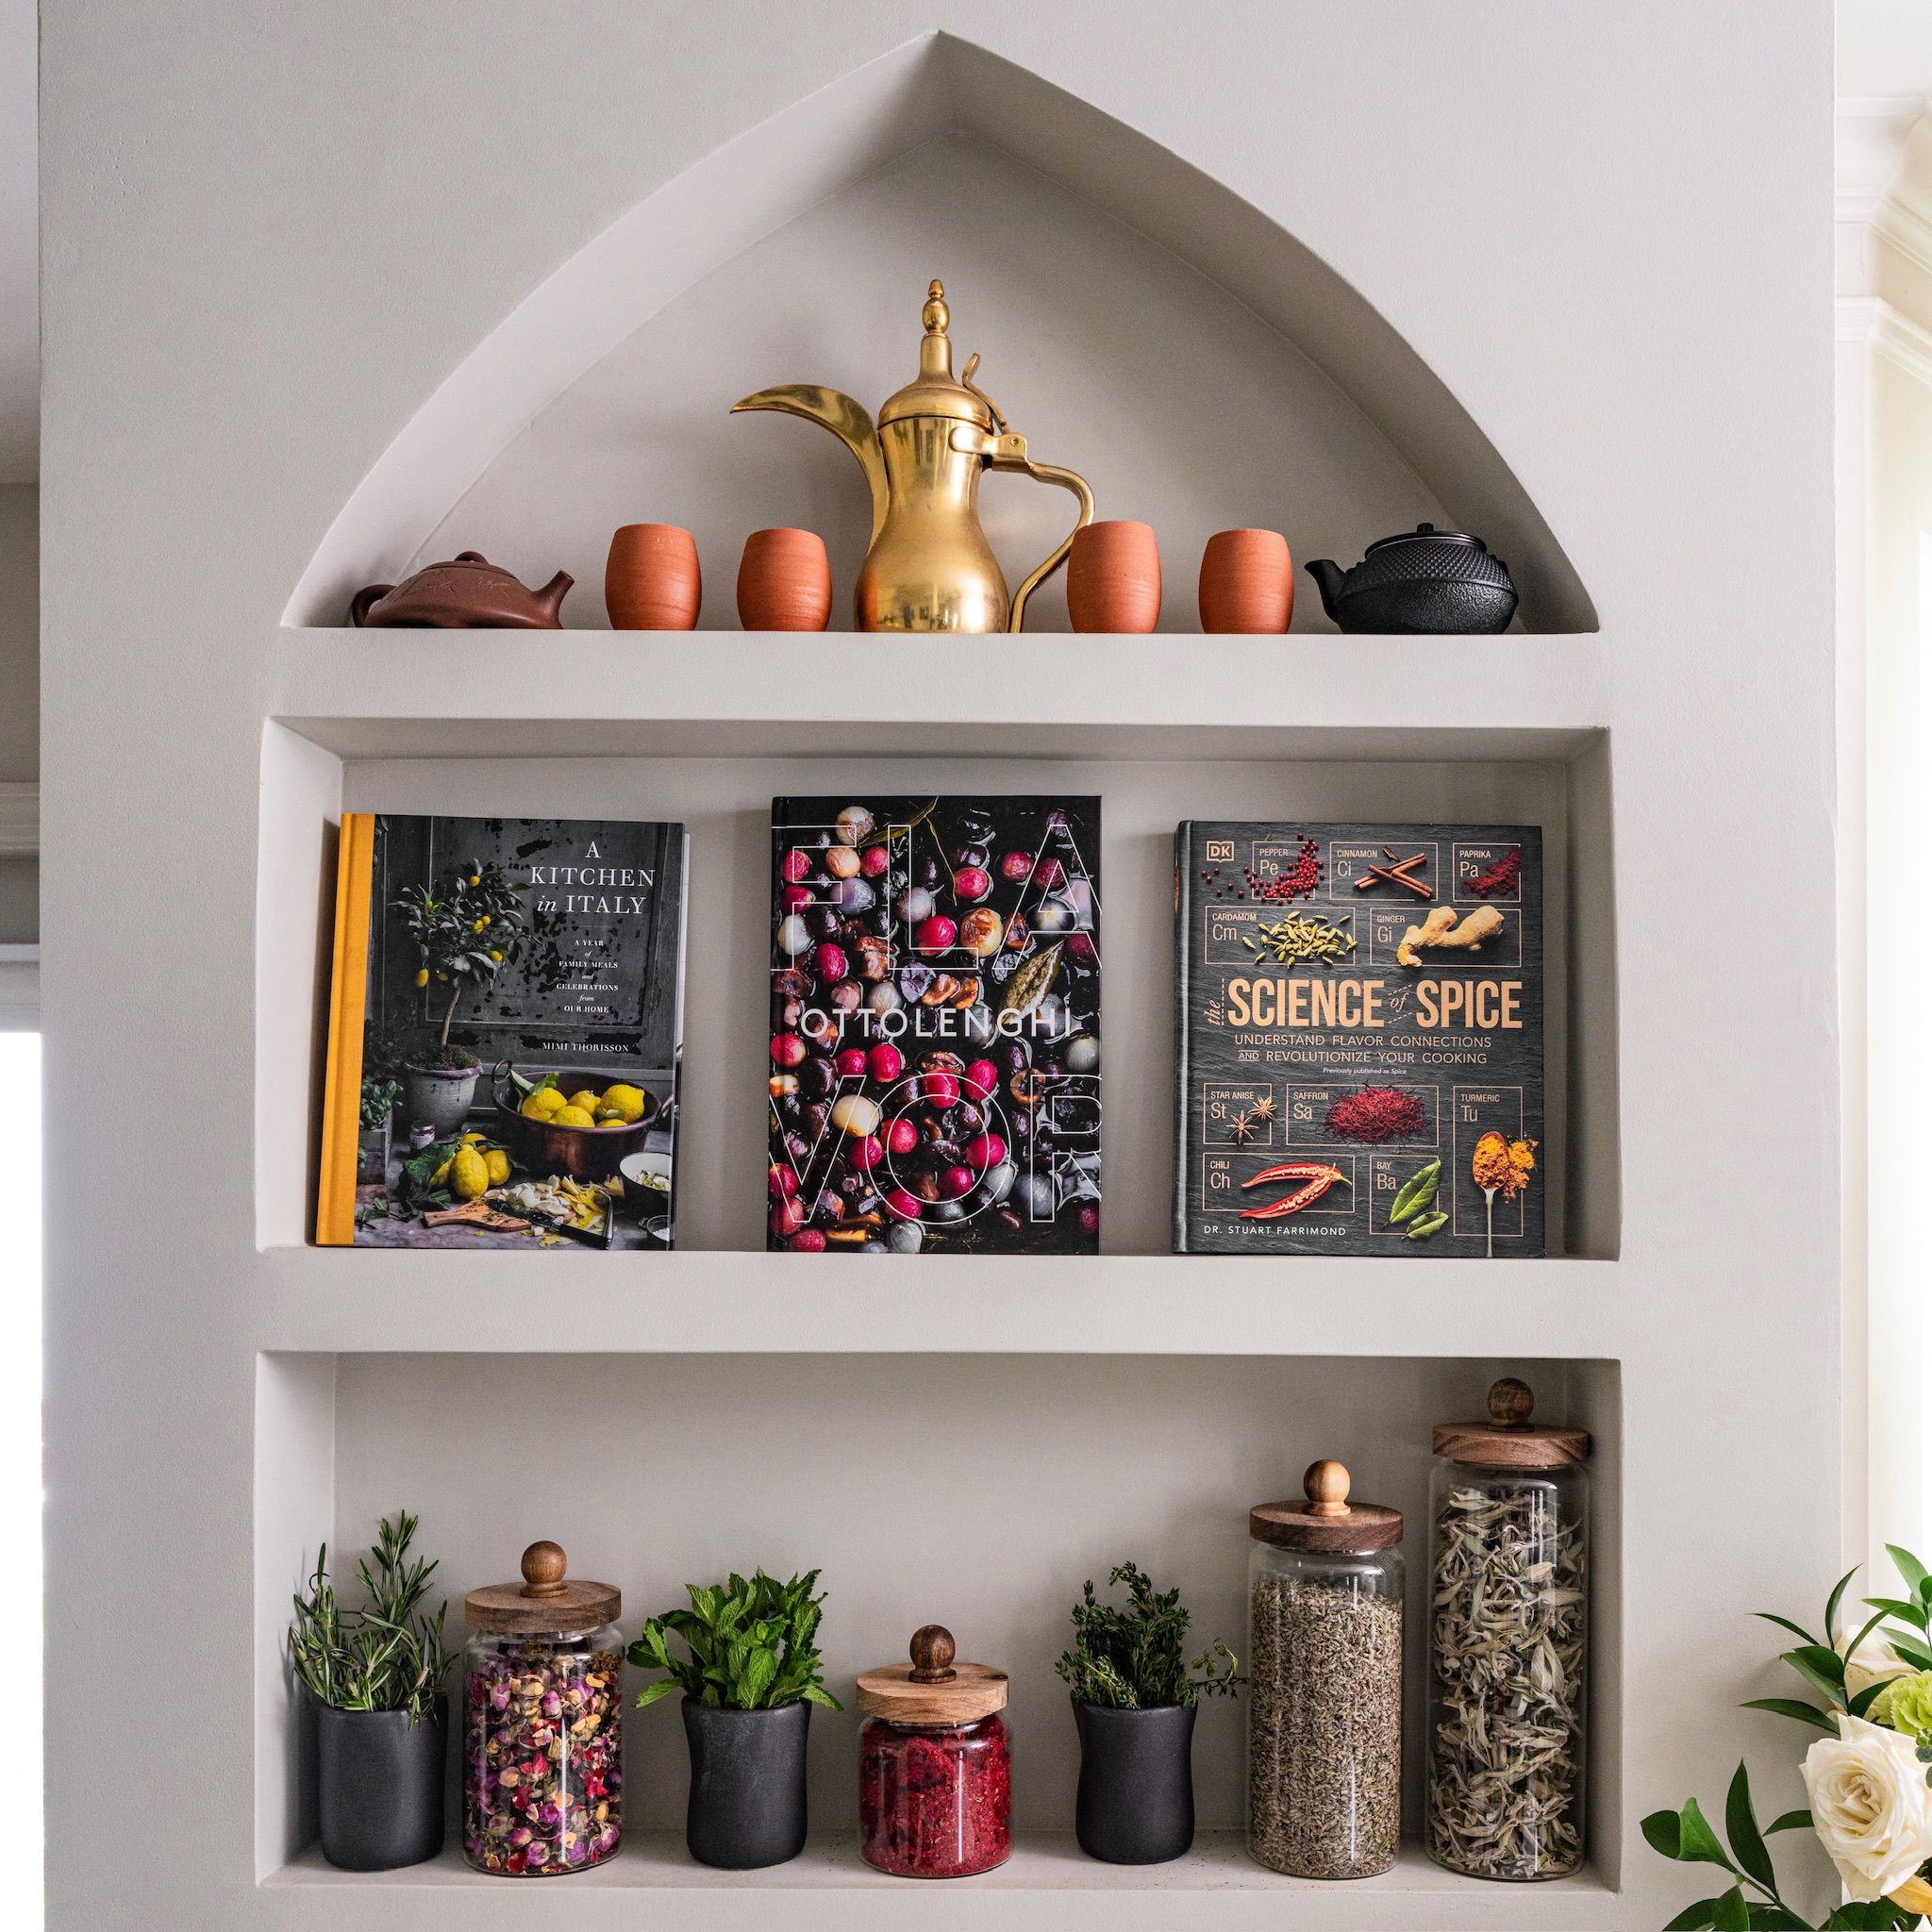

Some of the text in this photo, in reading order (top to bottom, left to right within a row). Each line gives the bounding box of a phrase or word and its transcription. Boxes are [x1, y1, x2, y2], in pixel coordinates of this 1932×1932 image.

[585, 841, 601, 858] A
[1210, 845, 1231, 858] DK
[1259, 848, 1289, 857] PEPPER
[1337, 849, 1378, 858] CINNAMON
[1459, 849, 1491, 858] PAPRIKA
[1259, 860, 1279, 875] Pe
[1337, 861, 1352, 877] Ci
[1459, 861, 1479, 878] Pa
[530, 866, 656, 887] KITCHEN
[537, 895, 647, 914] in ITALY
[1211, 912, 1257, 922] CARDAMOM
[1376, 914, 1406, 924] GINGER
[1211, 924, 1238, 941] Cm
[1377, 926, 1392, 942] Gi
[584, 950, 591, 958] of
[577, 994, 594, 1003] from
[1207, 978, 1524, 1028] the SCIENCE of SPICE
[564, 1005, 582, 1013] OUR
[799, 1007, 1073, 1039] OTTOLENGHI
[541, 1041, 629, 1052] MIMI THORISSON
[1234, 1034, 1491, 1048] UNDERSTAND FLAVOR CONNECTIONS
[1238, 1050, 1488, 1064] AND REVOLUTIONIZE YOUR COOKING
[1323, 1067, 1352, 1075] Previously
[1353, 1067, 1382, 1075] published
[1210, 1091, 1255, 1100] STAR ANISE
[1293, 1091, 1329, 1101] SAFFRON
[1460, 1093, 1501, 1103] TURMERIC
[1210, 1103, 1227, 1120] St
[1293, 1103, 1313, 1120] Sa
[1460, 1106, 1479, 1123] Tu
[1209, 1160, 1230, 1169] CHILI
[1376, 1161, 1391, 1170] BAY
[1209, 1172, 1230, 1190] Ch
[1376, 1174, 1397, 1191] Ba
[1204, 1225, 1347, 1236] DR. STUART FARRIMOND
